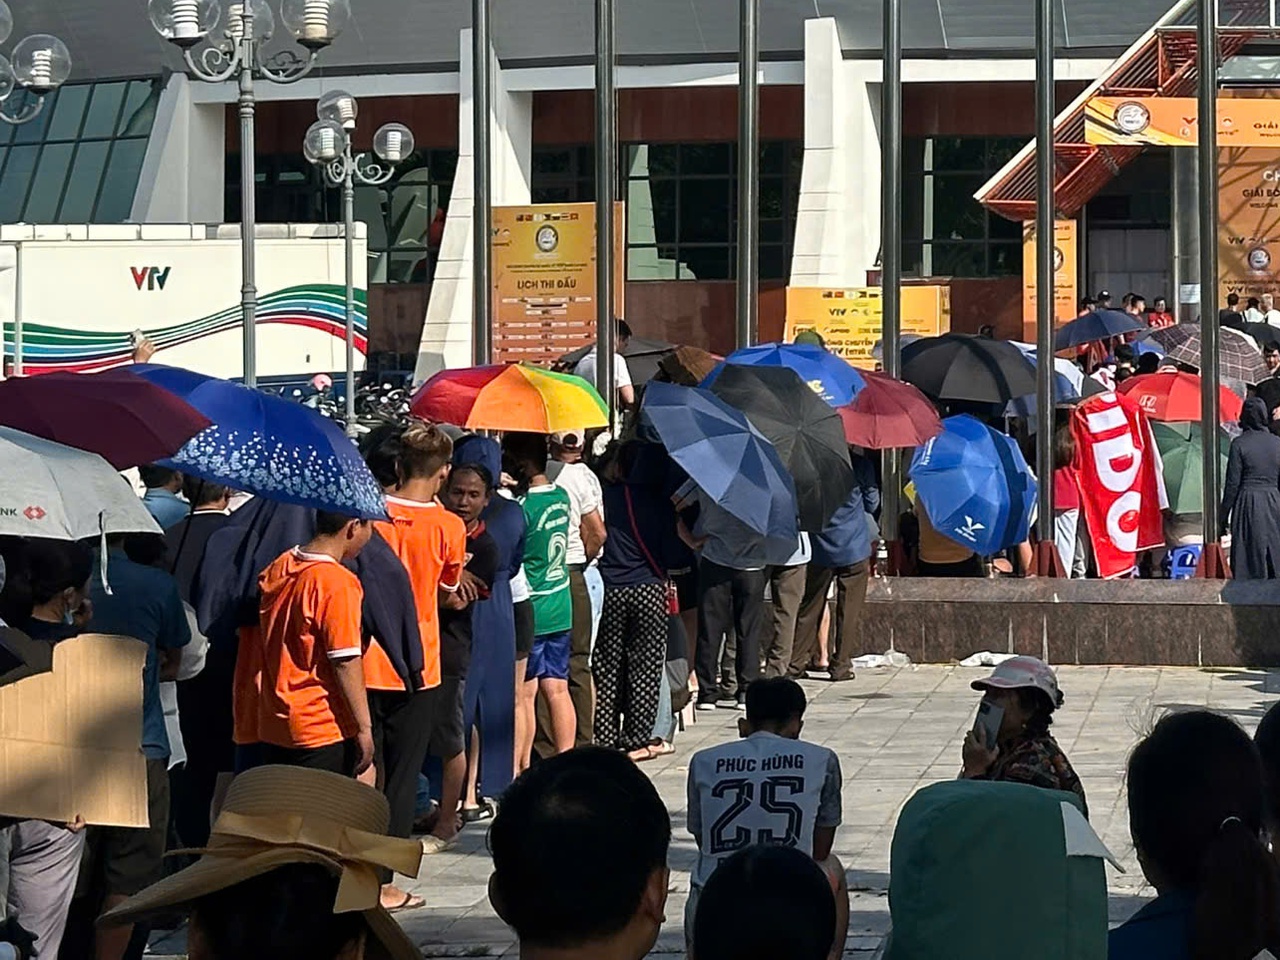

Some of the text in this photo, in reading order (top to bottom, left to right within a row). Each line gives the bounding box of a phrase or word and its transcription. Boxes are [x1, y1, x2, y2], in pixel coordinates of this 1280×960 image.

[130, 266, 171, 291] VTV
[541, 280, 555, 289] THI
[829, 308, 847, 316] VTV
[715, 756, 757, 773] PHÚC
[710, 776, 804, 854] 25
